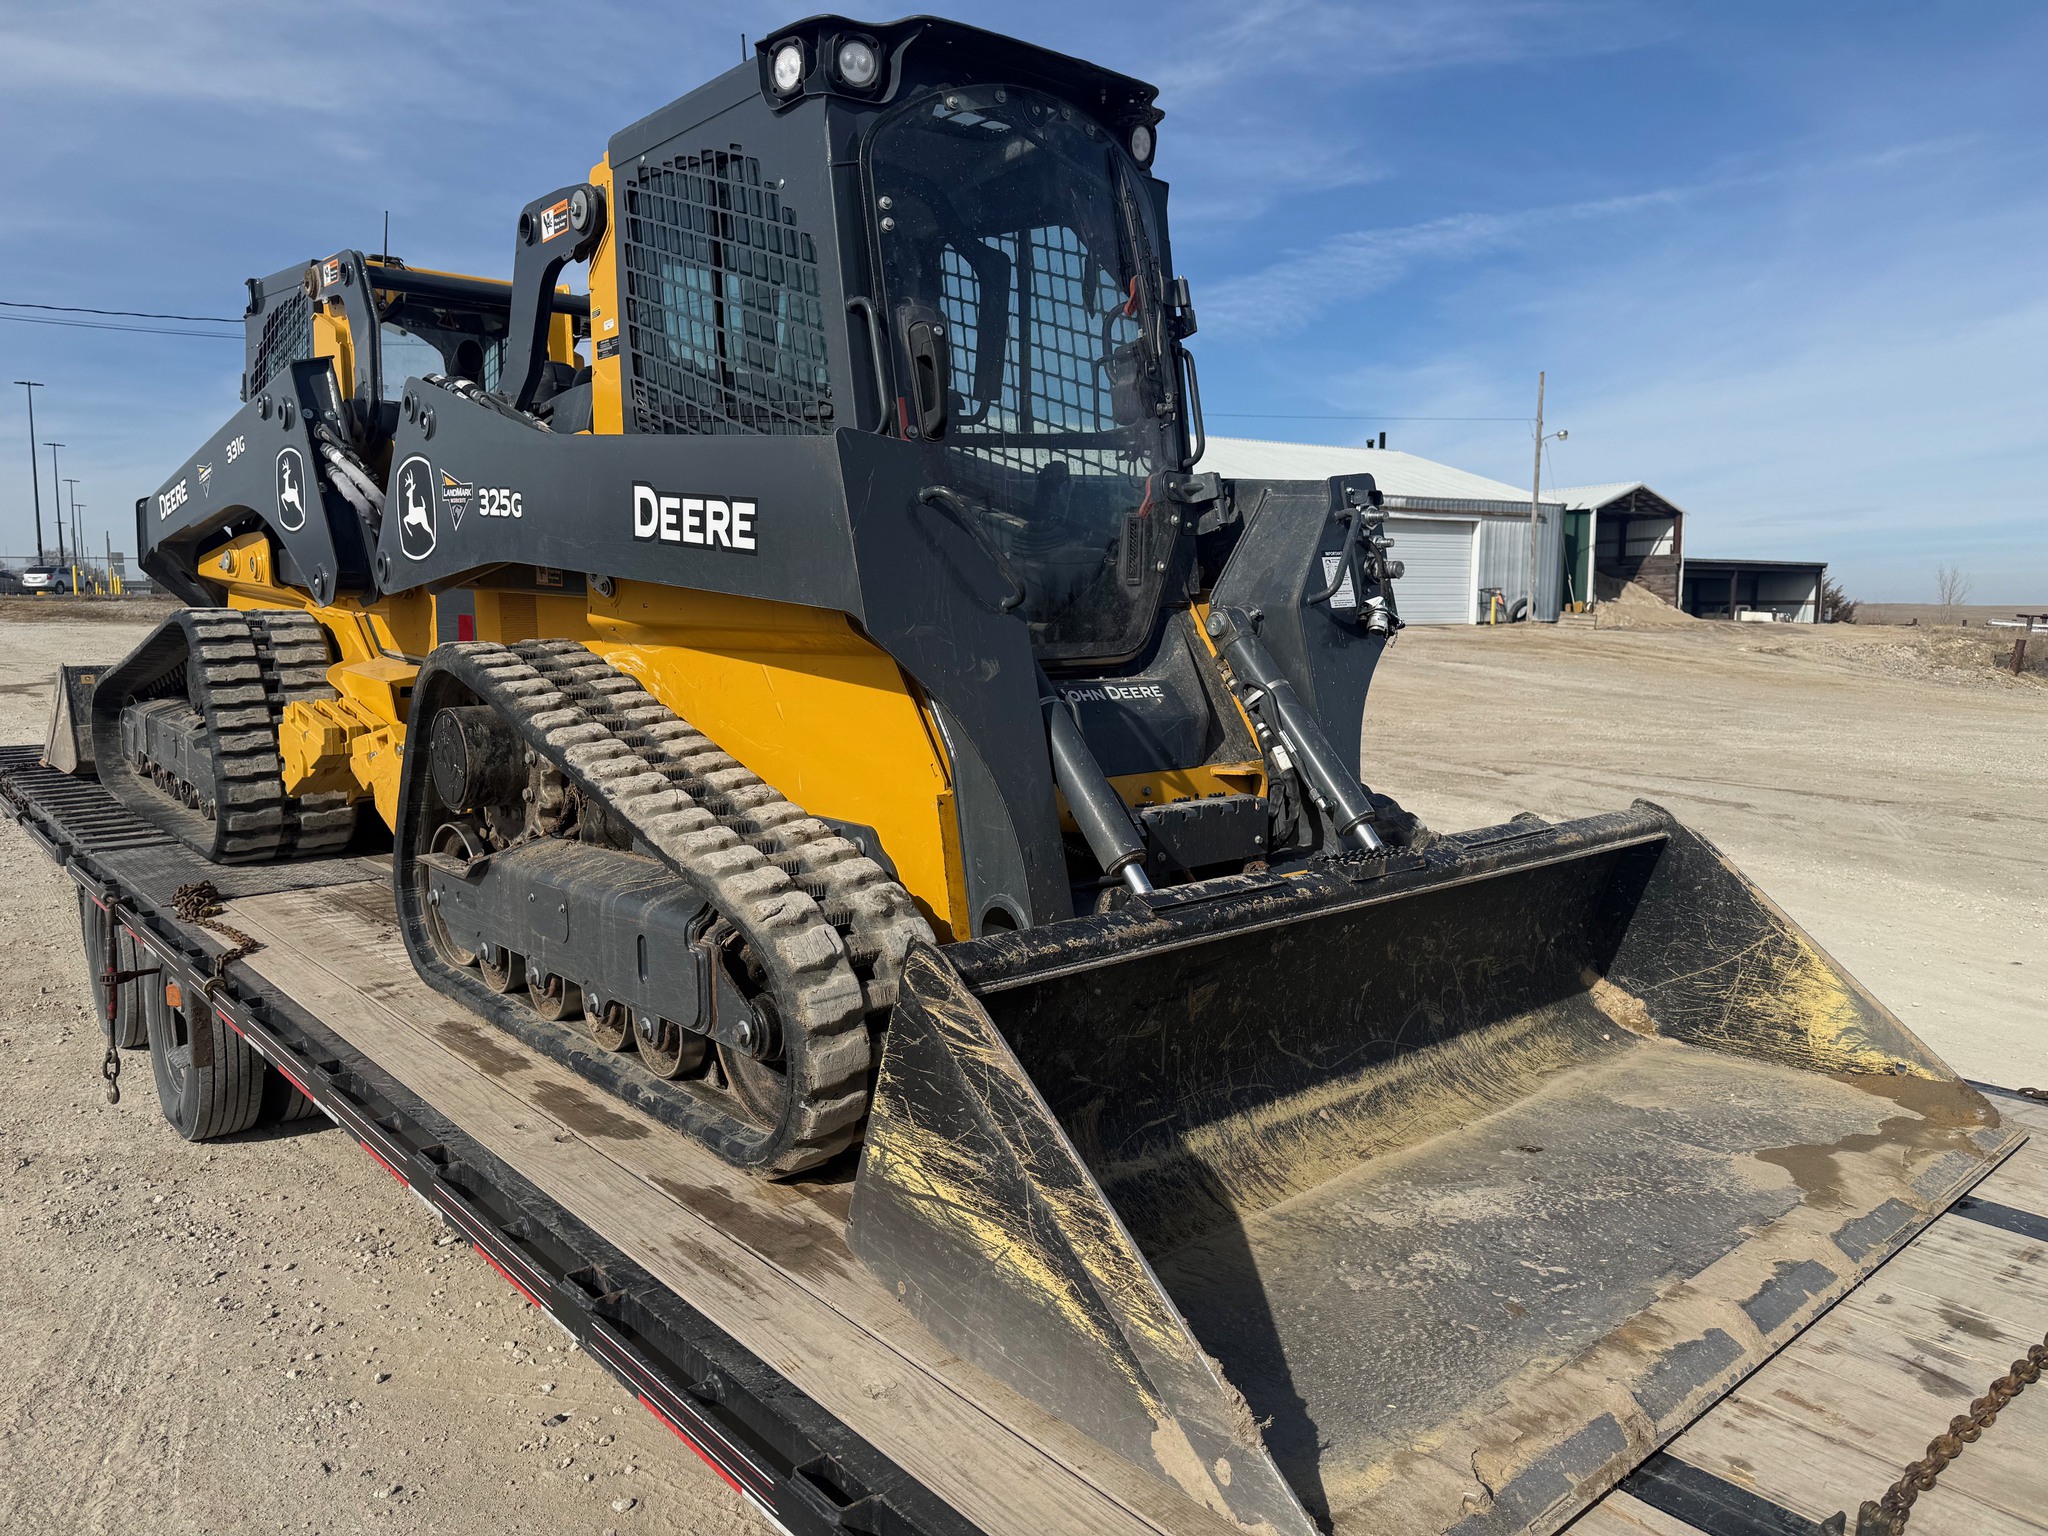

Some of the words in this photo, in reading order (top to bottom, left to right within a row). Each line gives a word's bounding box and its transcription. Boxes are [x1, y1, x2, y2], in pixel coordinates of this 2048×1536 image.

[226, 435, 246, 464] 331G
[158, 478, 188, 521] DEERE
[443, 487, 472, 497] LANDMARK
[478, 488, 522, 518] 325G
[633, 485, 756, 550] DEERE
[1104, 685, 1164, 700] DEERE
